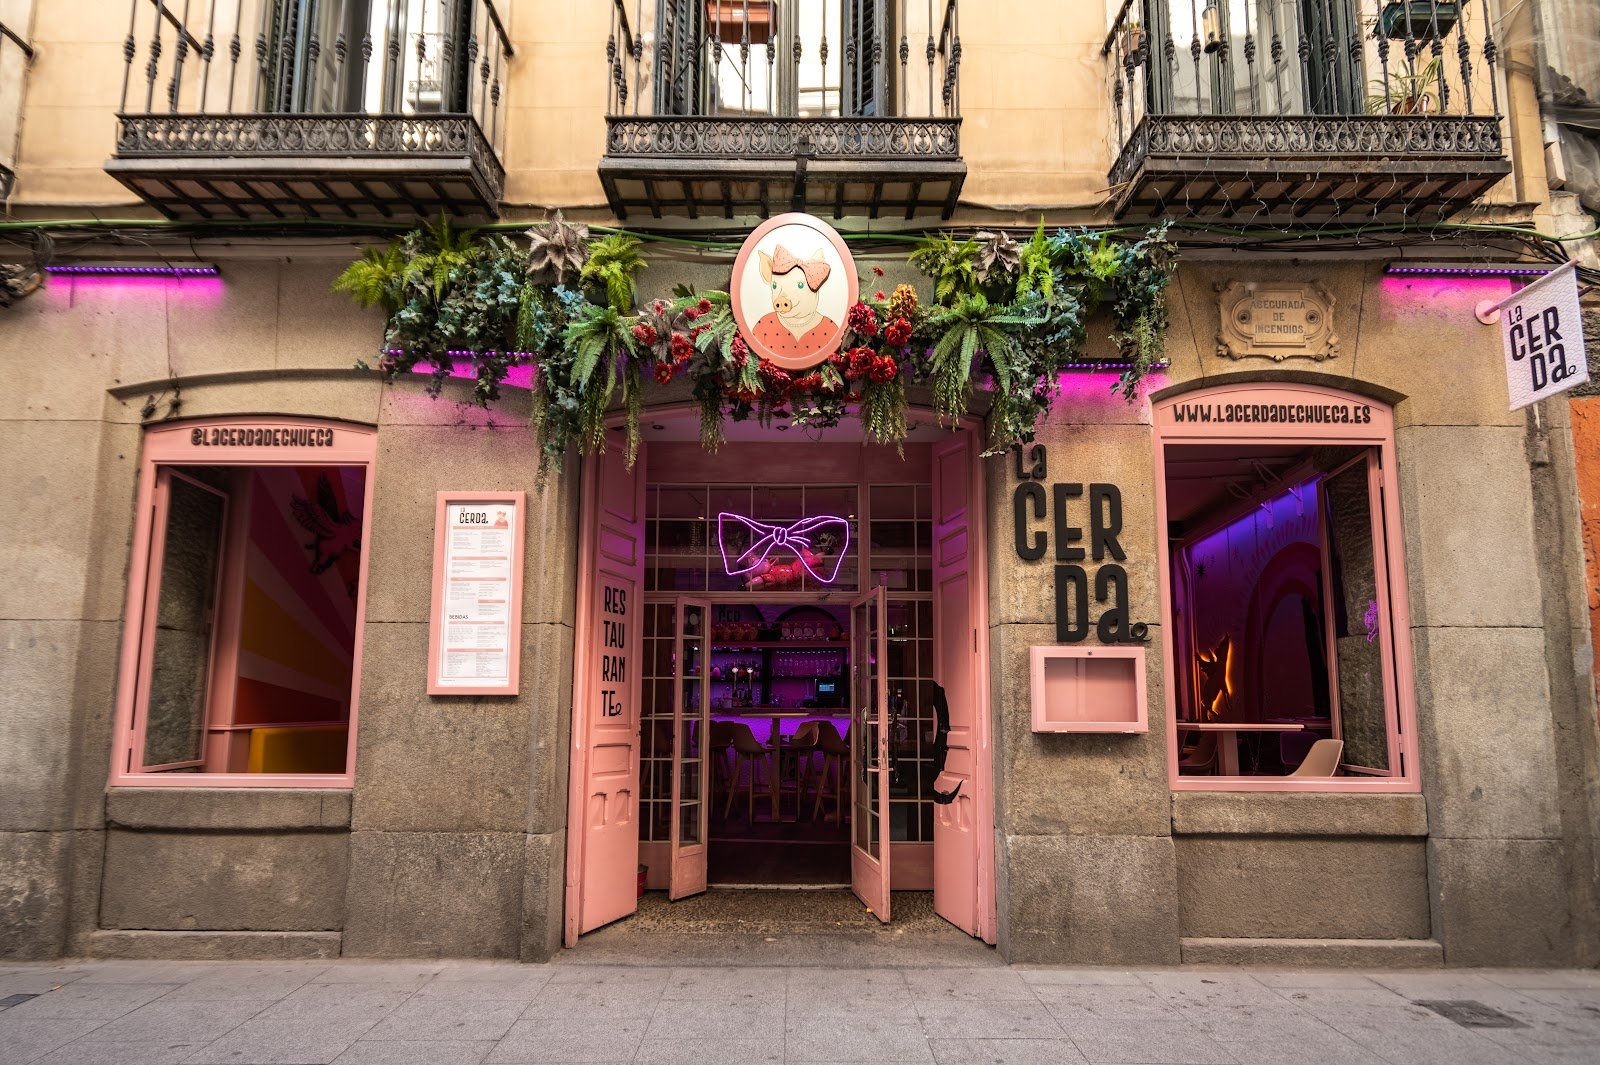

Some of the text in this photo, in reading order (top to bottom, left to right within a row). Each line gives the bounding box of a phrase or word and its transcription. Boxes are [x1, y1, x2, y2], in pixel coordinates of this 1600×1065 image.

[1250, 300, 1306, 310] ASEGURADA
[1273, 312, 1285, 321] DE
[1509, 306, 1563, 361] CER
[1014, 481, 1127, 561] CER
[604, 586, 626, 615] RES
[603, 620, 625, 648] TAU
[602, 655, 625, 682] RAN
